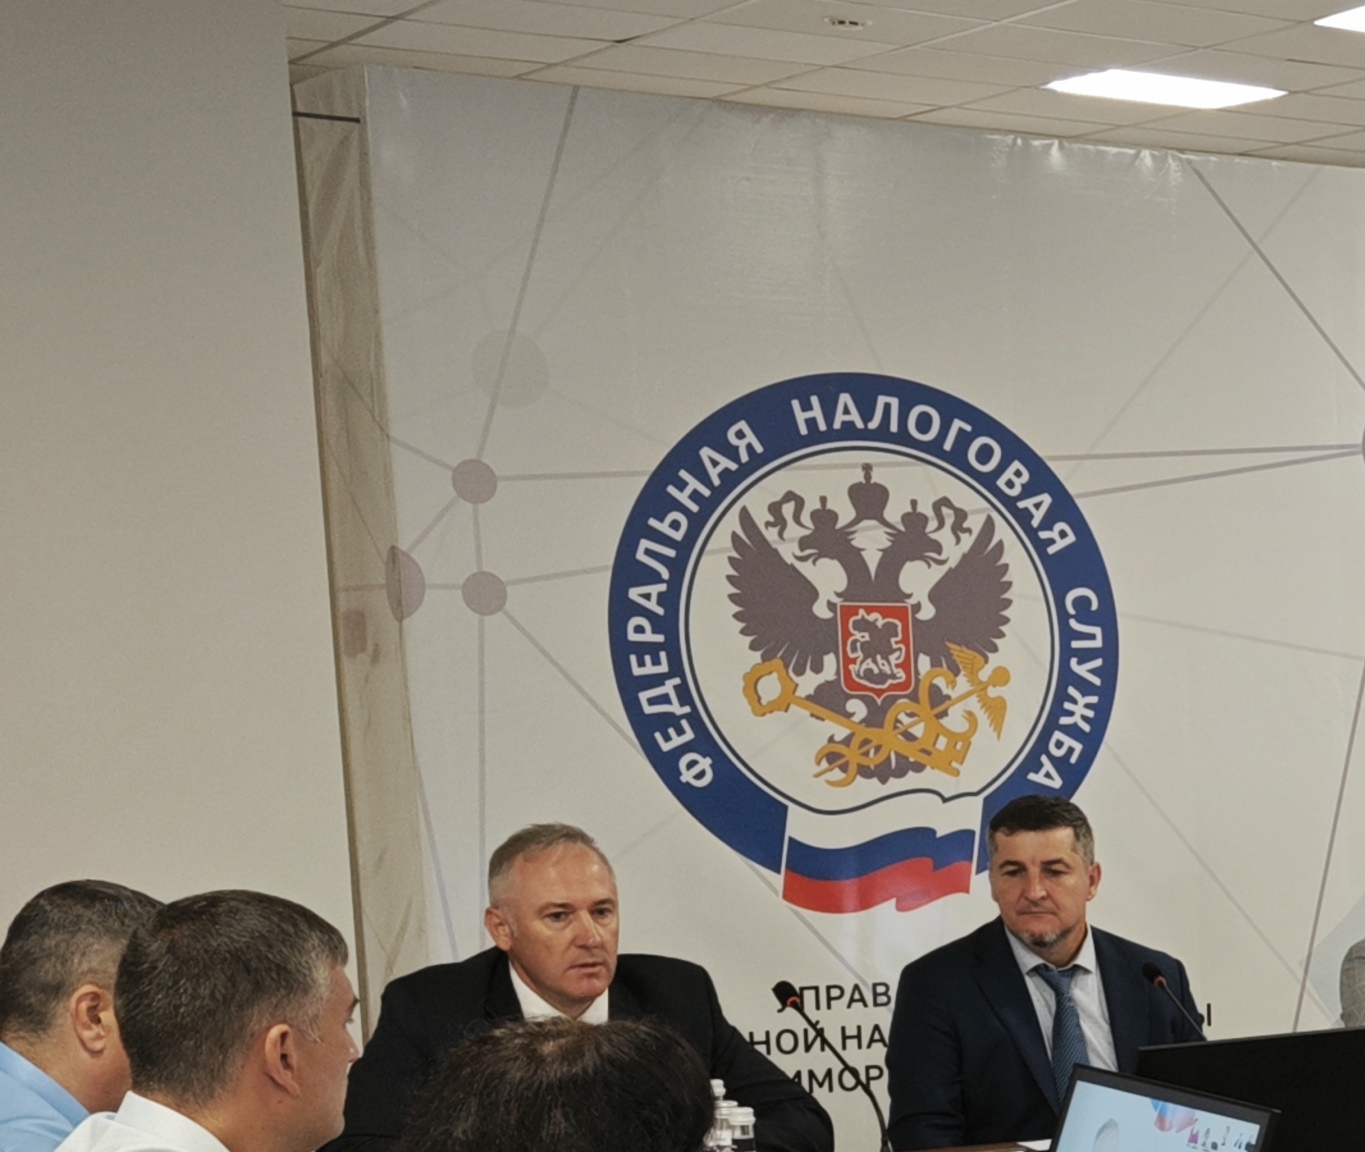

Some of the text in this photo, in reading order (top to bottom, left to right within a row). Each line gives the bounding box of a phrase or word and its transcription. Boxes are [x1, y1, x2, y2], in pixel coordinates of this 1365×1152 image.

[626, 391, 1104, 791] ФЕДЕРАЛЬНАЯ НАЛОГОВАЯ СЛУЖБА
[777, 981, 892, 1014] ПРАВ
